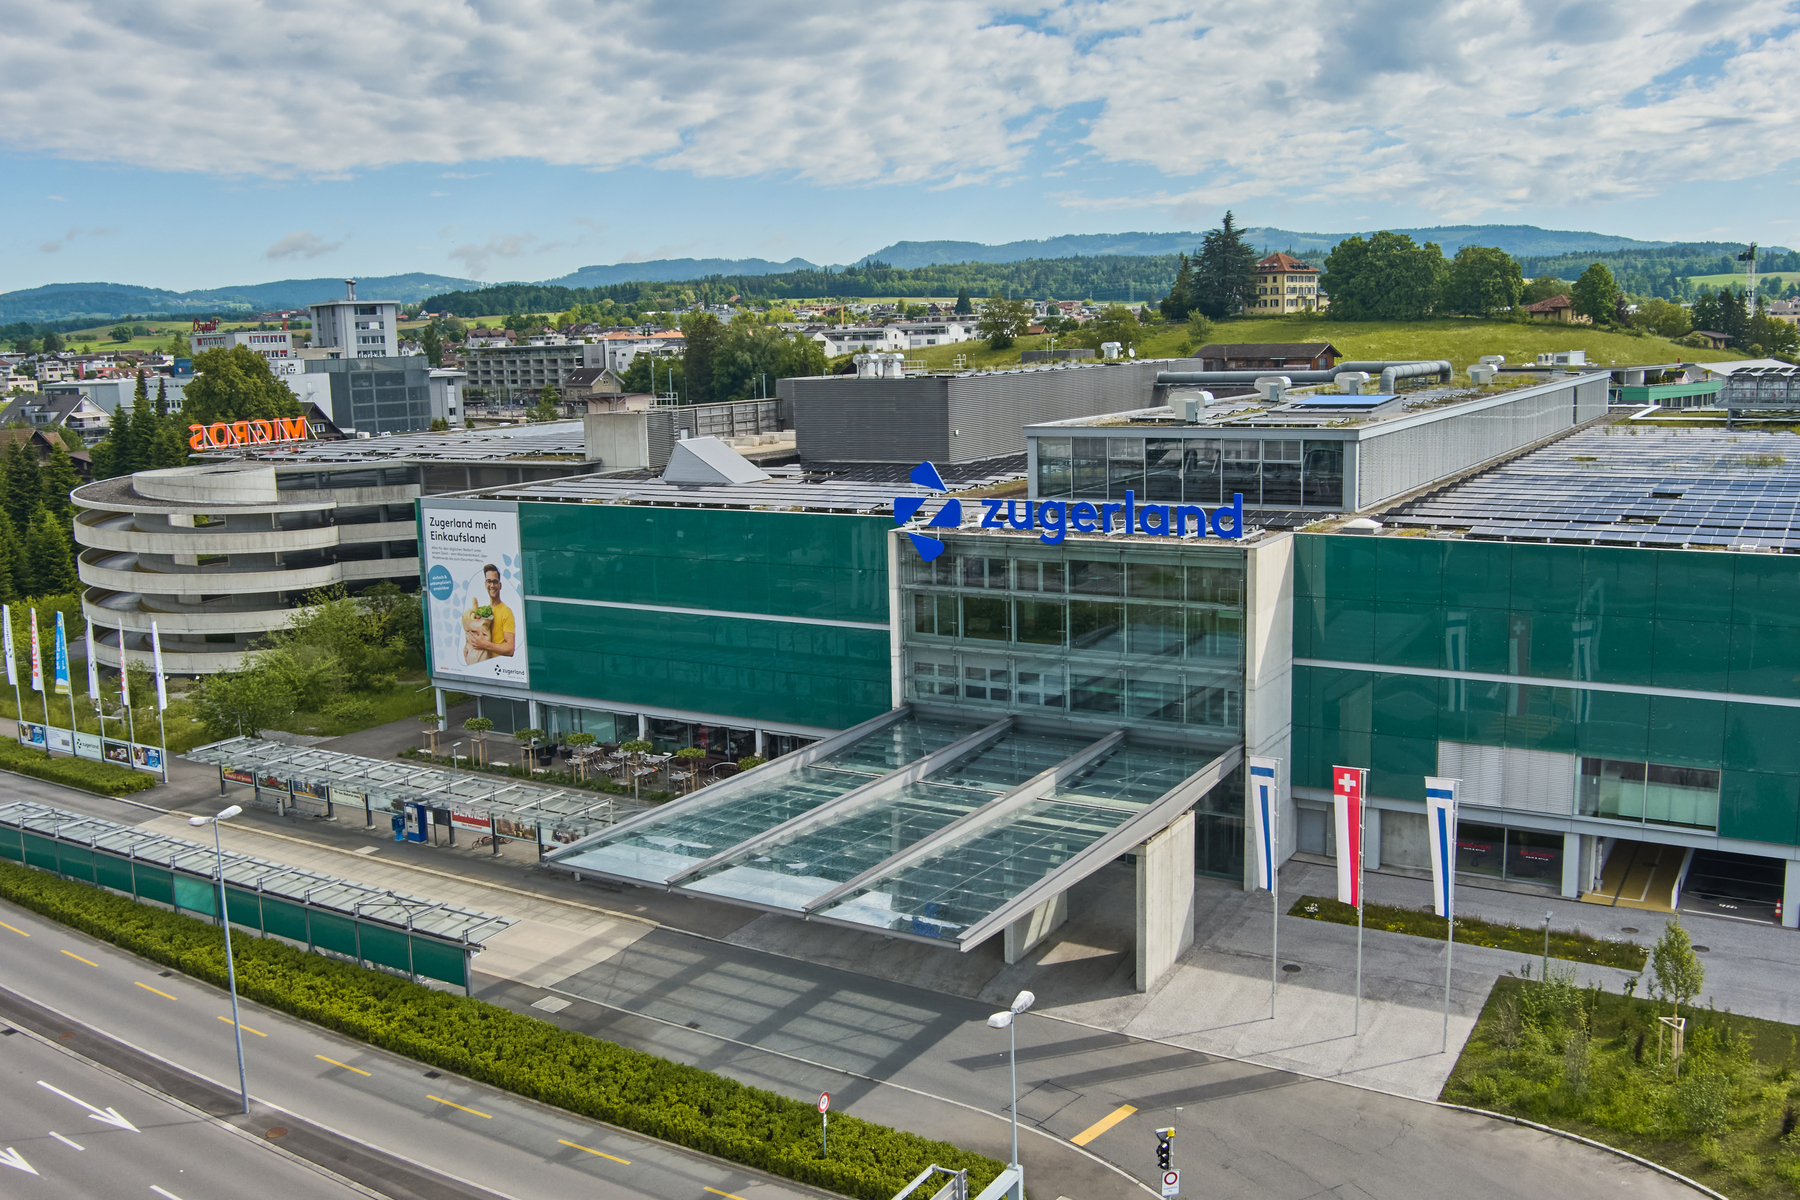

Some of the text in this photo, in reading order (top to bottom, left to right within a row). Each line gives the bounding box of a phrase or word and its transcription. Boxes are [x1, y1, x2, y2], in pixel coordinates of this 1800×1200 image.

[981, 489, 1243, 545] zugerland
[429, 517, 497, 530] Zugerland mein
[430, 531, 486, 543] Einkaufsland
[502, 668, 525, 676] zugerland
[82, 742, 99, 750] zugerland
[453, 808, 488, 821] DENNER
[1458, 842, 1491, 850] BUCHER
[1520, 850, 1554, 858] BUCHER
